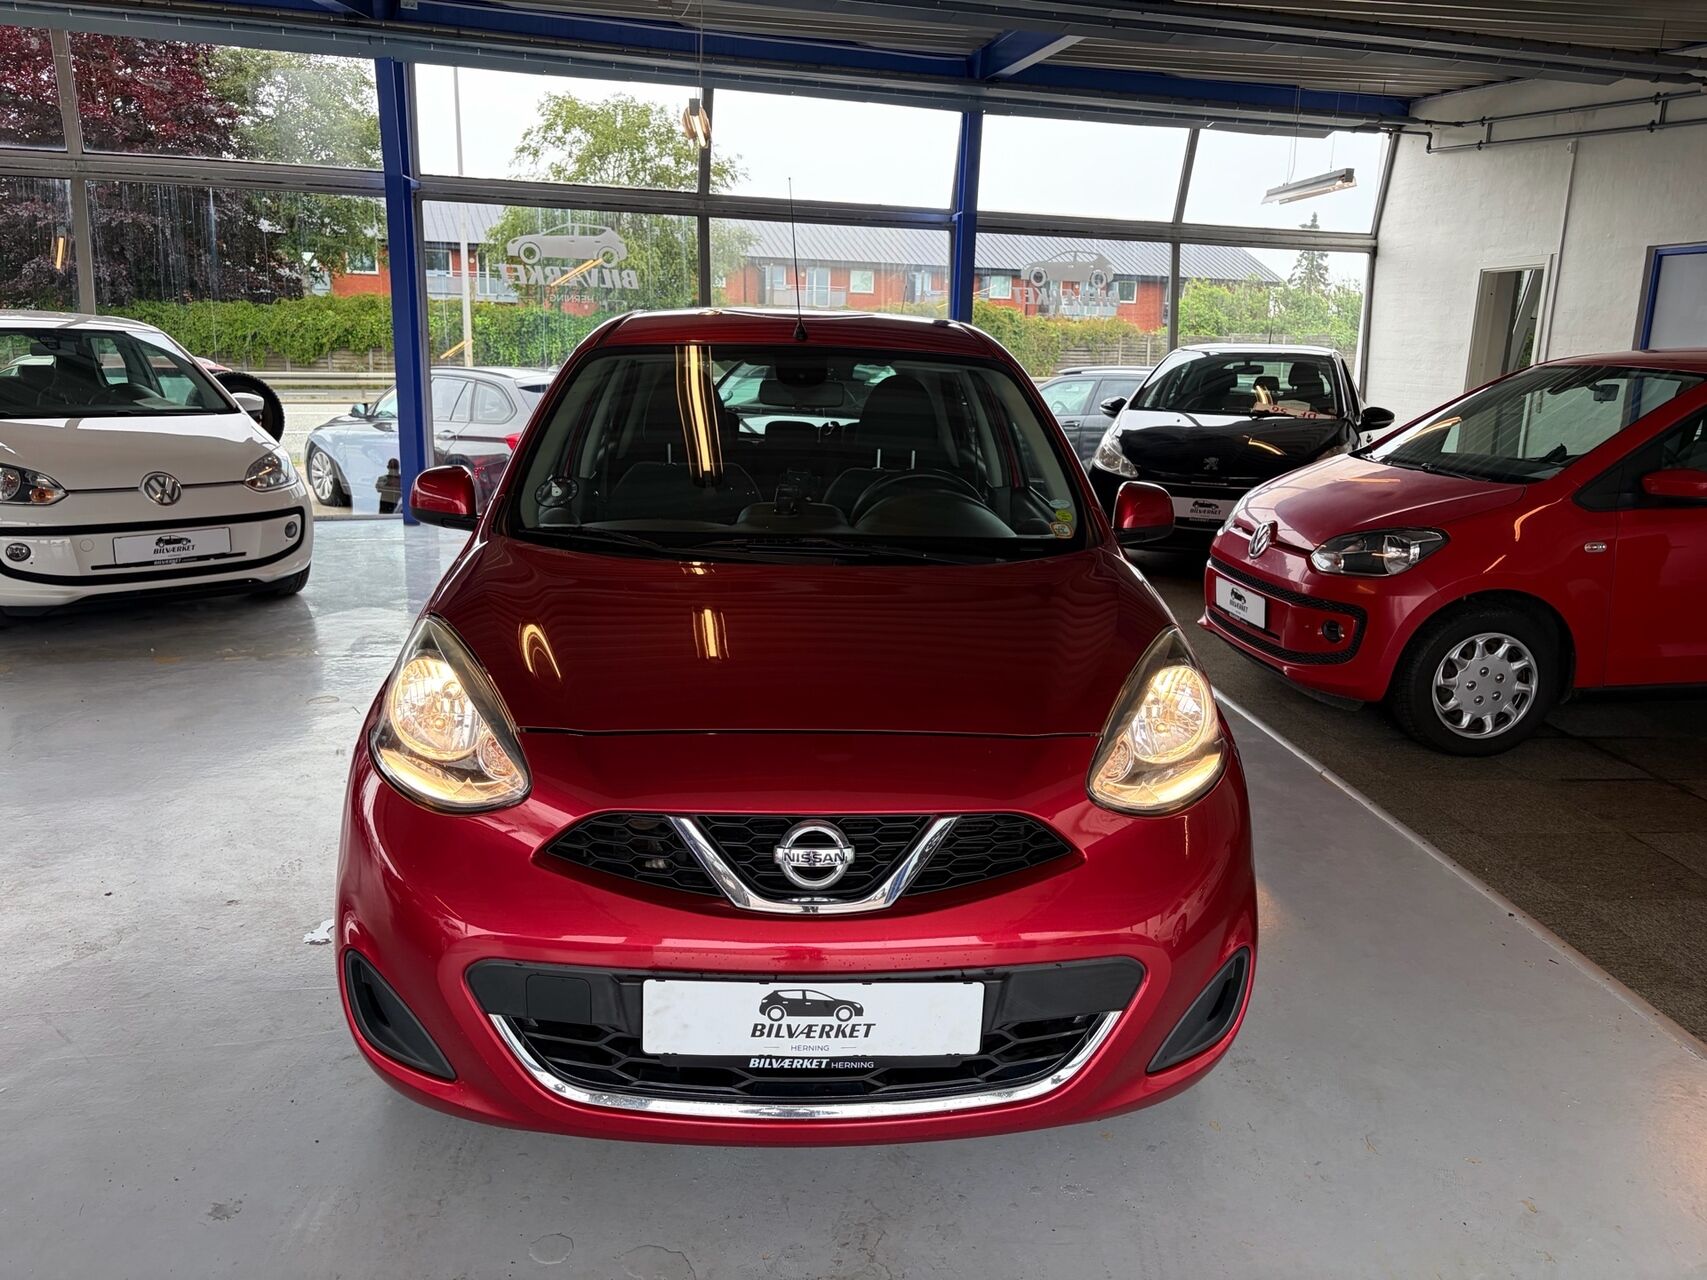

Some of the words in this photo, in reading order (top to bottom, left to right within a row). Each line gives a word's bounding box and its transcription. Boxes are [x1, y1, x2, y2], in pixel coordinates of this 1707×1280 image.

[783, 852, 845, 863] NISSAN
[750, 1023, 876, 1039] BILVÆRKET
[791, 1044, 830, 1052] HERNING
[749, 1057, 829, 1069] BILVÆRKET
[831, 1061, 874, 1069] HERNING
